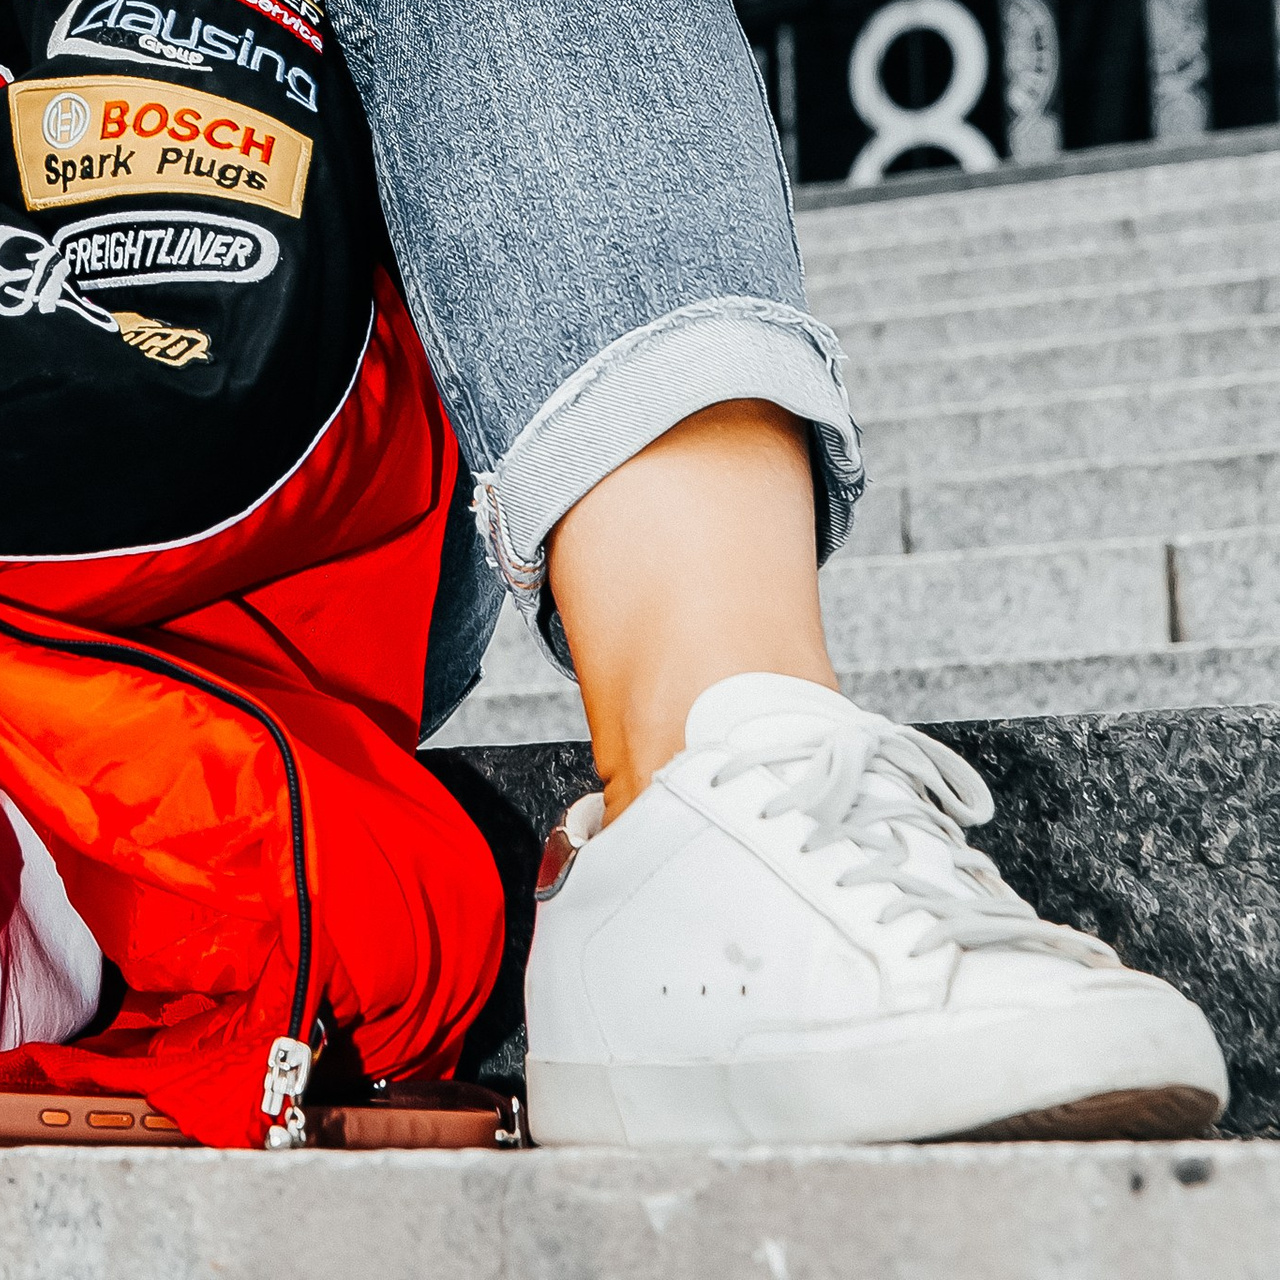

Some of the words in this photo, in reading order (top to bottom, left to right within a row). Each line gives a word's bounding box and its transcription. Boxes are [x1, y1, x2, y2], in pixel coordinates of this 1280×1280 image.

[138, 34, 205, 66] Group
[99, 99, 277, 166] BOSCH
[44, 144, 136, 193] Spark
[156, 147, 269, 191] Plugs
[65, 227, 255, 275] FREIGHTLINER
